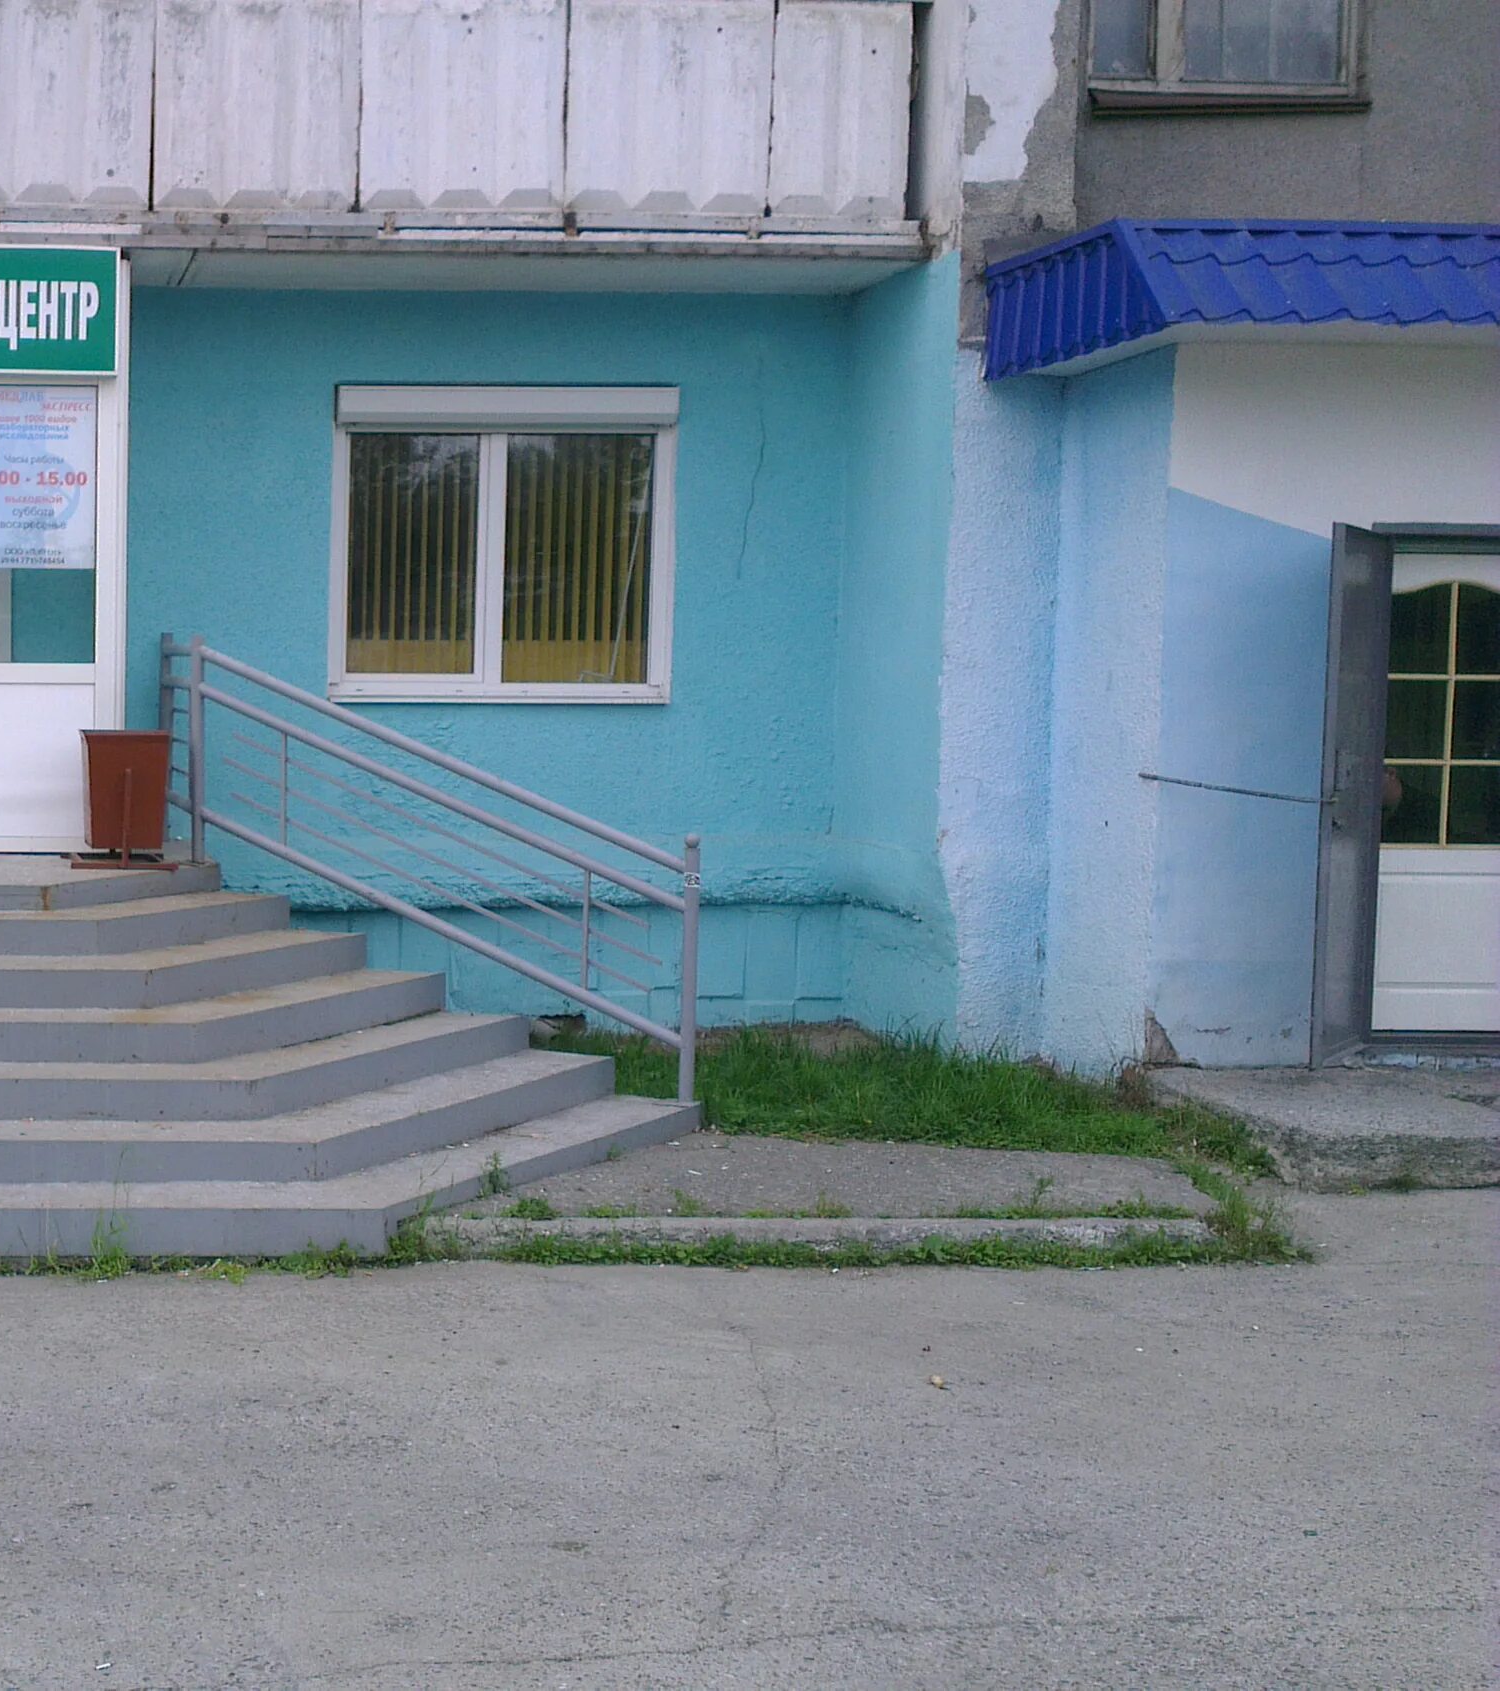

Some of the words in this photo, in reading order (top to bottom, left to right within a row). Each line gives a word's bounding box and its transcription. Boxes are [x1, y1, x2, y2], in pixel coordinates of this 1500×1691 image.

[41, 402, 92, 411] ЭКСПРЕСС
[4, 455, 29, 464] Часы
[31, 455, 65, 465] работы
[36, 471, 88, 486] 15.00
[12, 506, 55, 518] суббота
[0, 520, 67, 530] воскресенье
